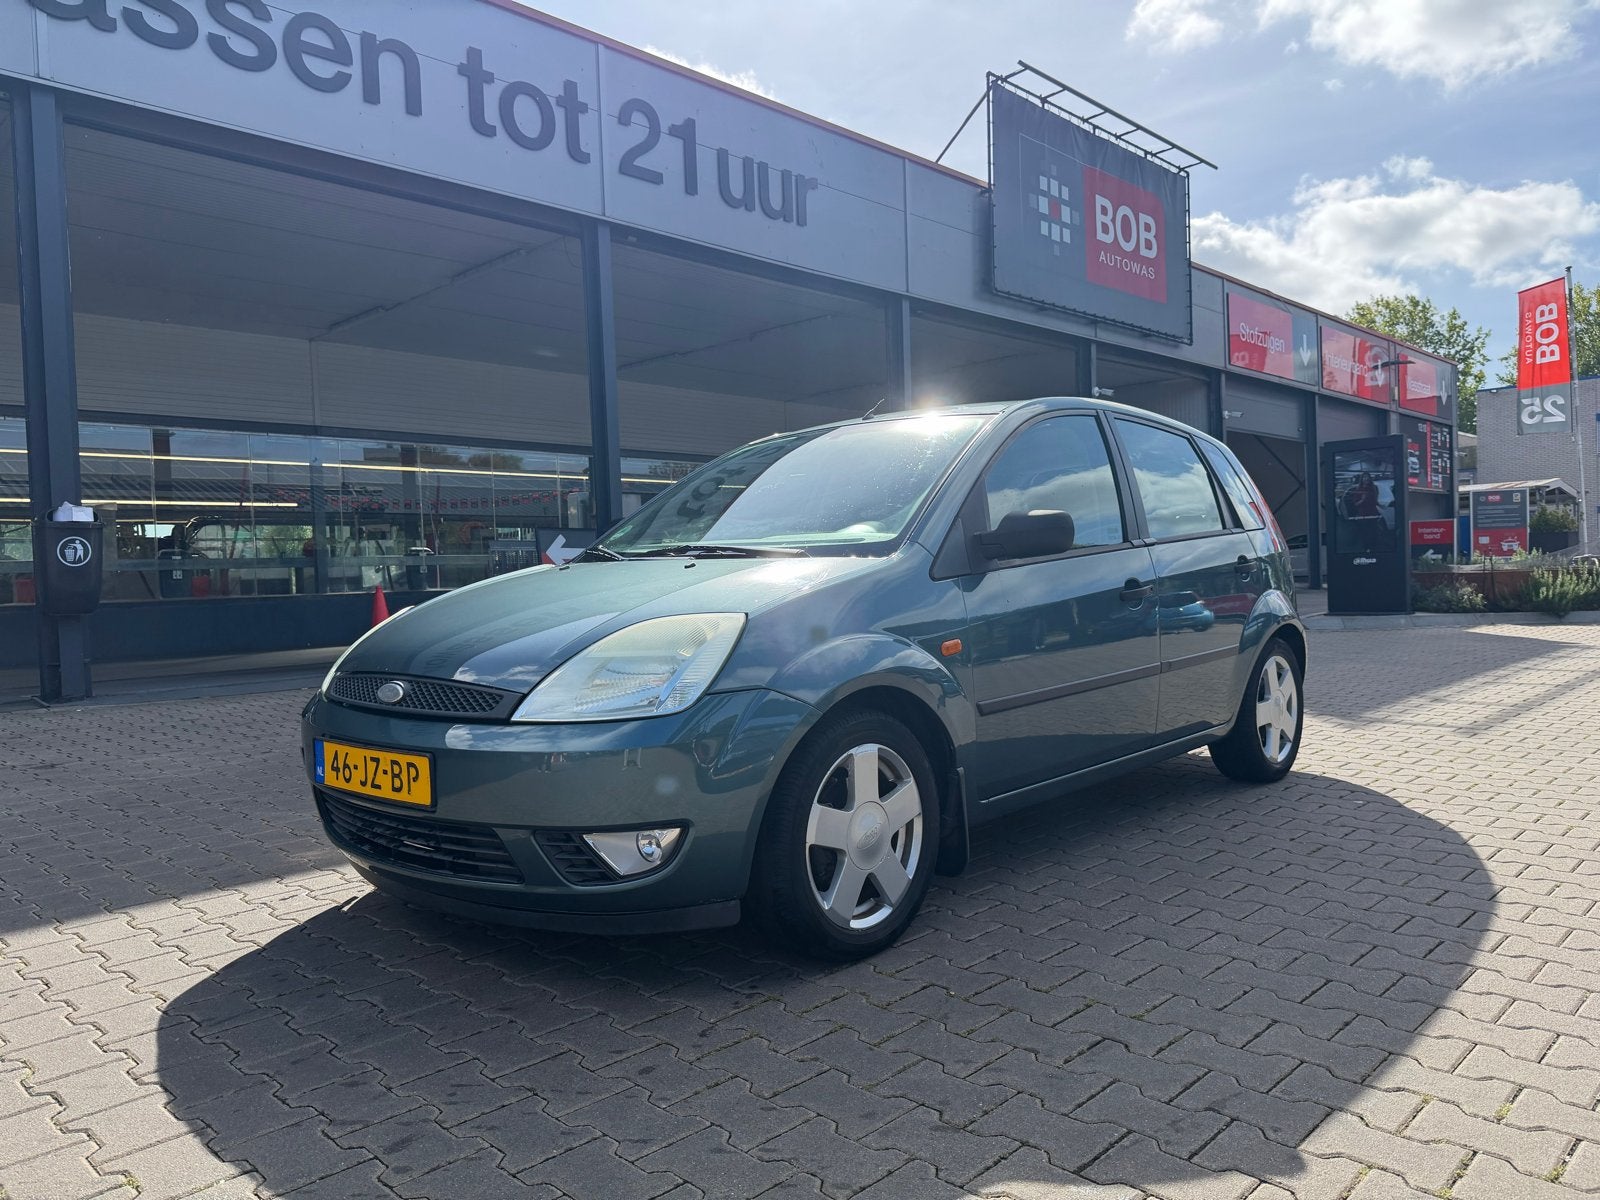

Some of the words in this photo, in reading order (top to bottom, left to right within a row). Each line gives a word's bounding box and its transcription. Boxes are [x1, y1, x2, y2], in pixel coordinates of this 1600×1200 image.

[456, 45, 591, 165] tot
[617, 98, 698, 196] 21
[716, 147, 818, 227] uur
[1095, 194, 1158, 259] BOB
[1099, 250, 1155, 279] AUTOWAS
[1239, 322, 1285, 354] Stofzuigen
[316, 765, 324, 777] NL
[330, 750, 420, 795] 46-JZ-BP
